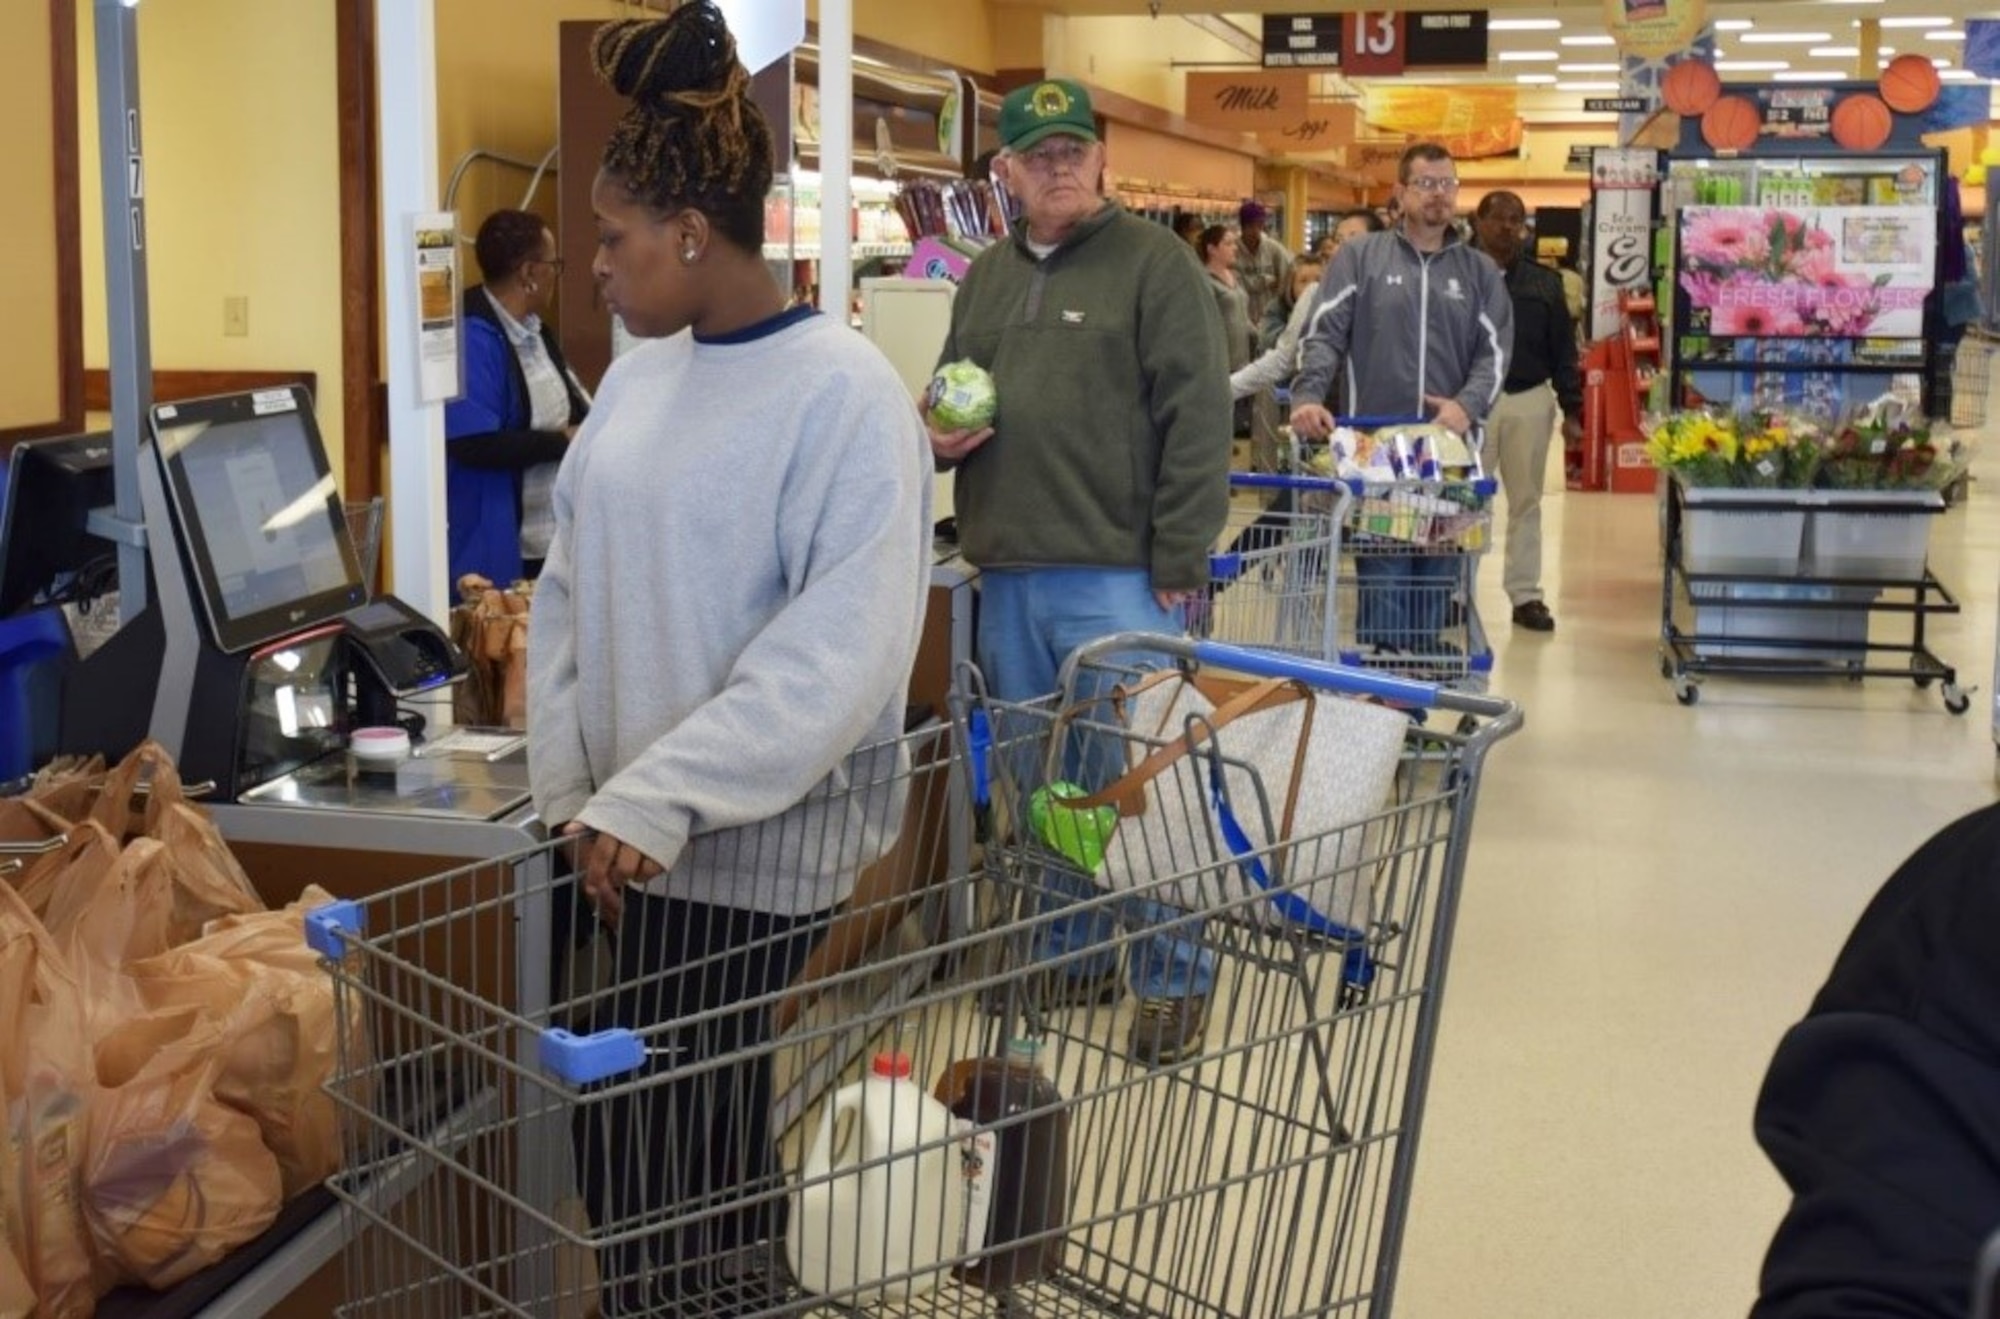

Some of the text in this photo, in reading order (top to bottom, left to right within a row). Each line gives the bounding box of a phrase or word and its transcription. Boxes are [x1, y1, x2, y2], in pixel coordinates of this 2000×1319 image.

[1355, 11, 1396, 54] 13
[1214, 85, 1280, 111] Milk
[1605, 100, 1640, 110] CREAM
[1598, 222, 1648, 233] Cream
[1719, 287, 1924, 307] FRESH FLOWERS
